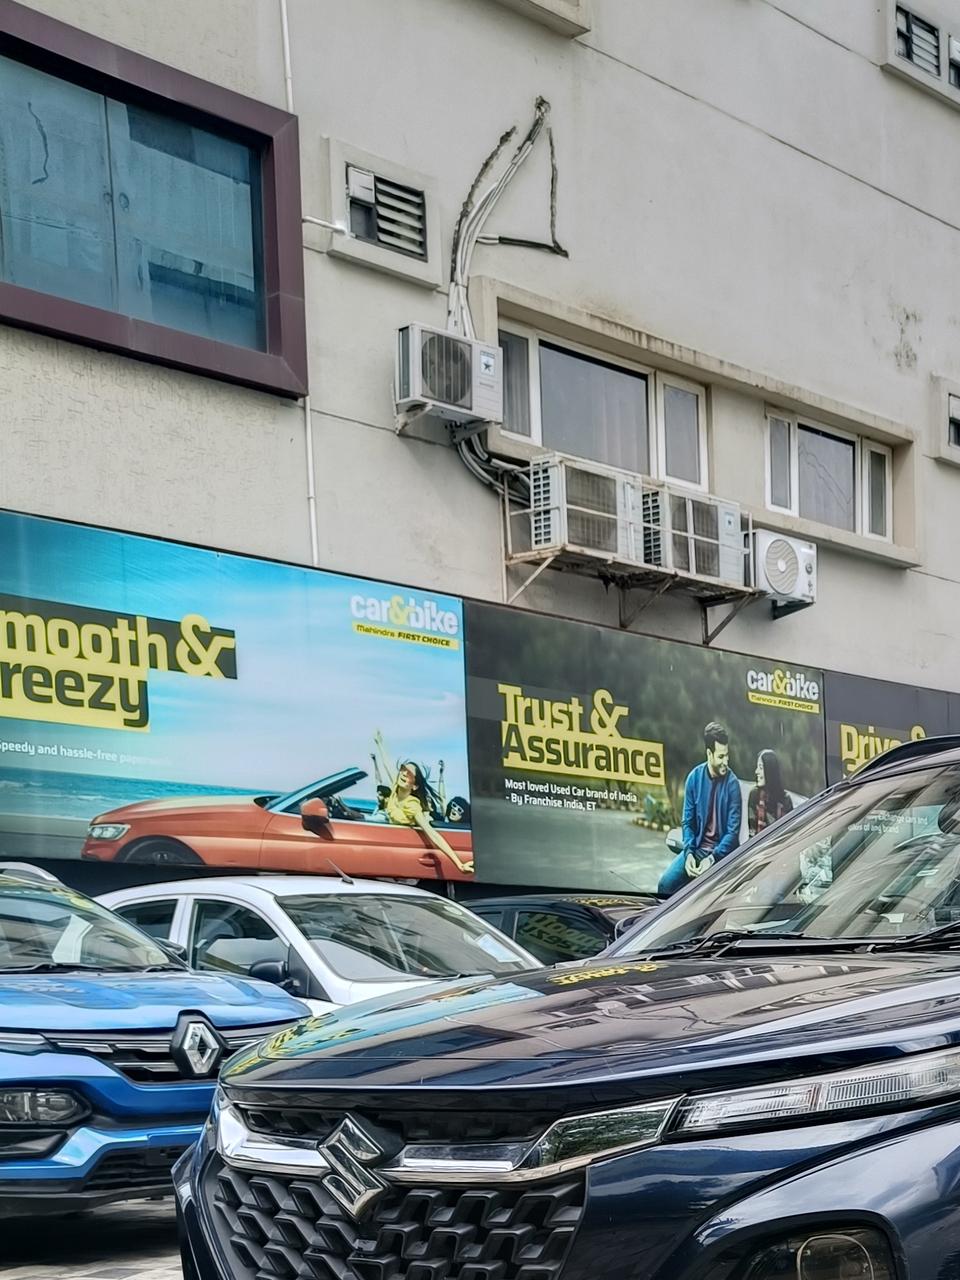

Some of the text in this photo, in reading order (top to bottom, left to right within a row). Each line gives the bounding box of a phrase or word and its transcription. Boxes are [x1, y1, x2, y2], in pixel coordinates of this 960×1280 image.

[350, 594, 459, 635] car&bike
[176, 613, 236, 679] &
[398, 631, 422, 643] FIRST
[422, 636, 450, 647] CHOICE
[747, 669, 819, 701] car&bike
[498, 683, 630, 738] Trust &
[37, 744, 58, 756] and
[60, 746, 118, 762] hassle-free
[503, 723, 661, 778] Assurance
[504, 778, 637, 803] Most loved Used Car brand of India
[511, 793, 523, 806] By
[524, 795, 563, 808] Franchise
[563, 799, 586, 812] India,
[586, 801, 597, 811] ET
